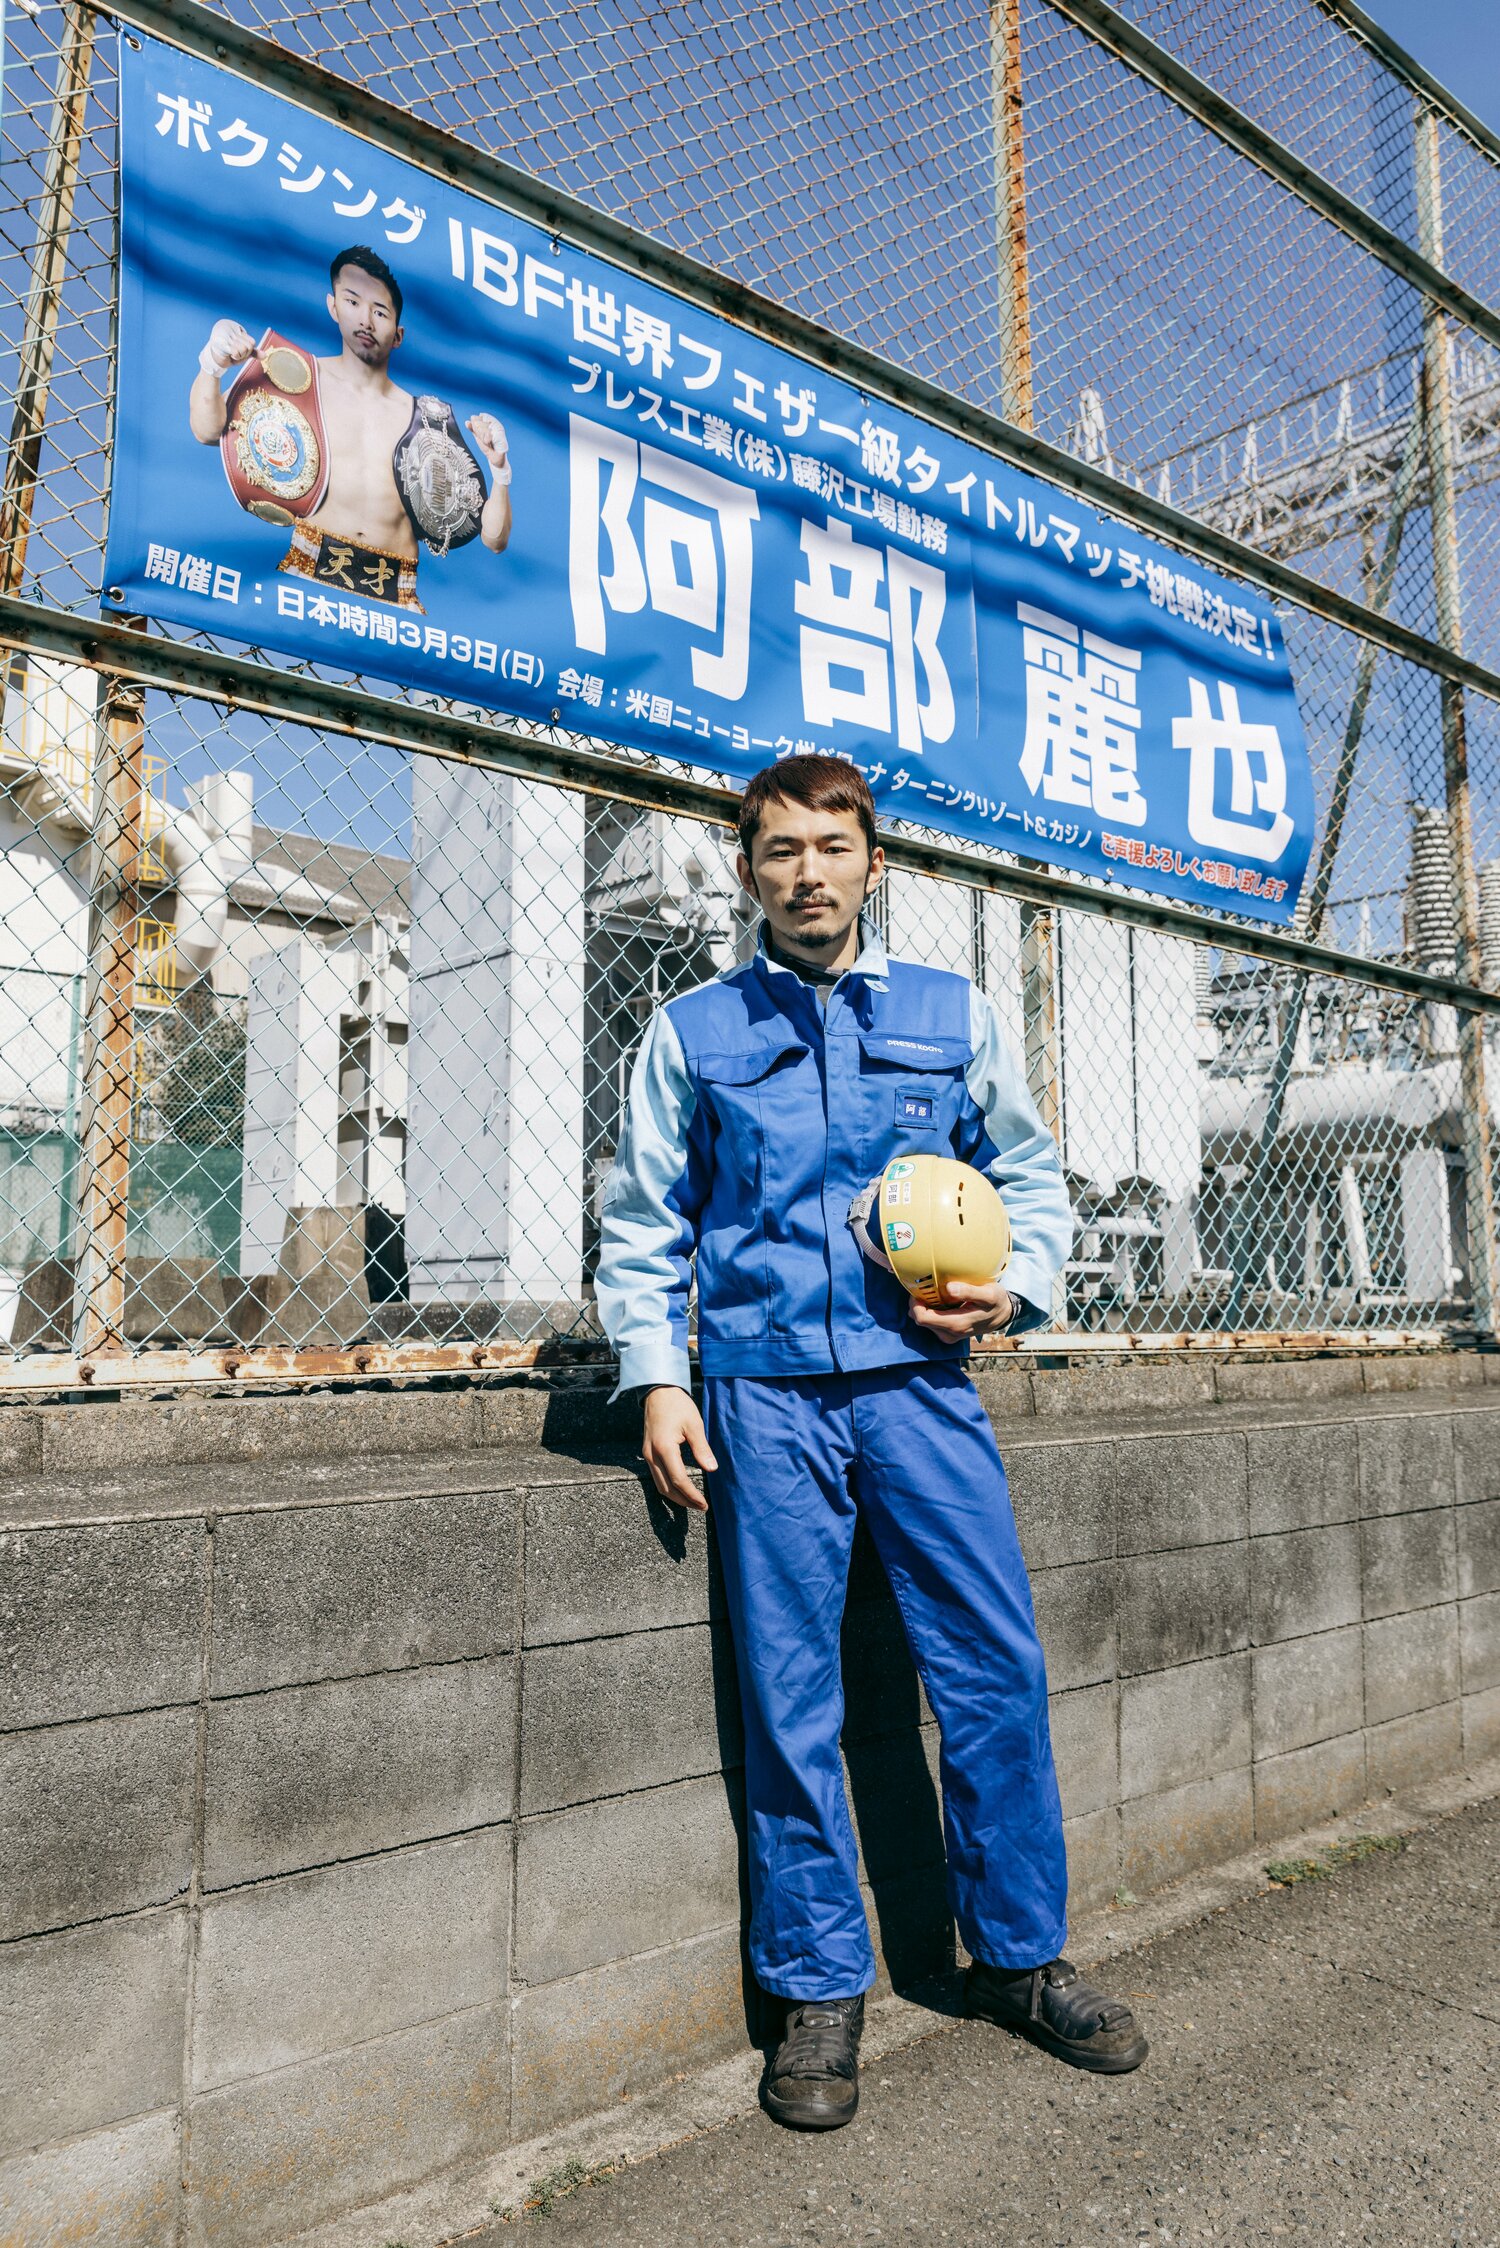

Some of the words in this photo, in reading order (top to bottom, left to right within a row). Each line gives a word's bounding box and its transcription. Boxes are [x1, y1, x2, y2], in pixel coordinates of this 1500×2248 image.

[156, 93, 427, 244] ボクシング
[319, 545, 395, 596] 天才
[1101, 831, 1289, 902] ご声援よろしくお願い致します
